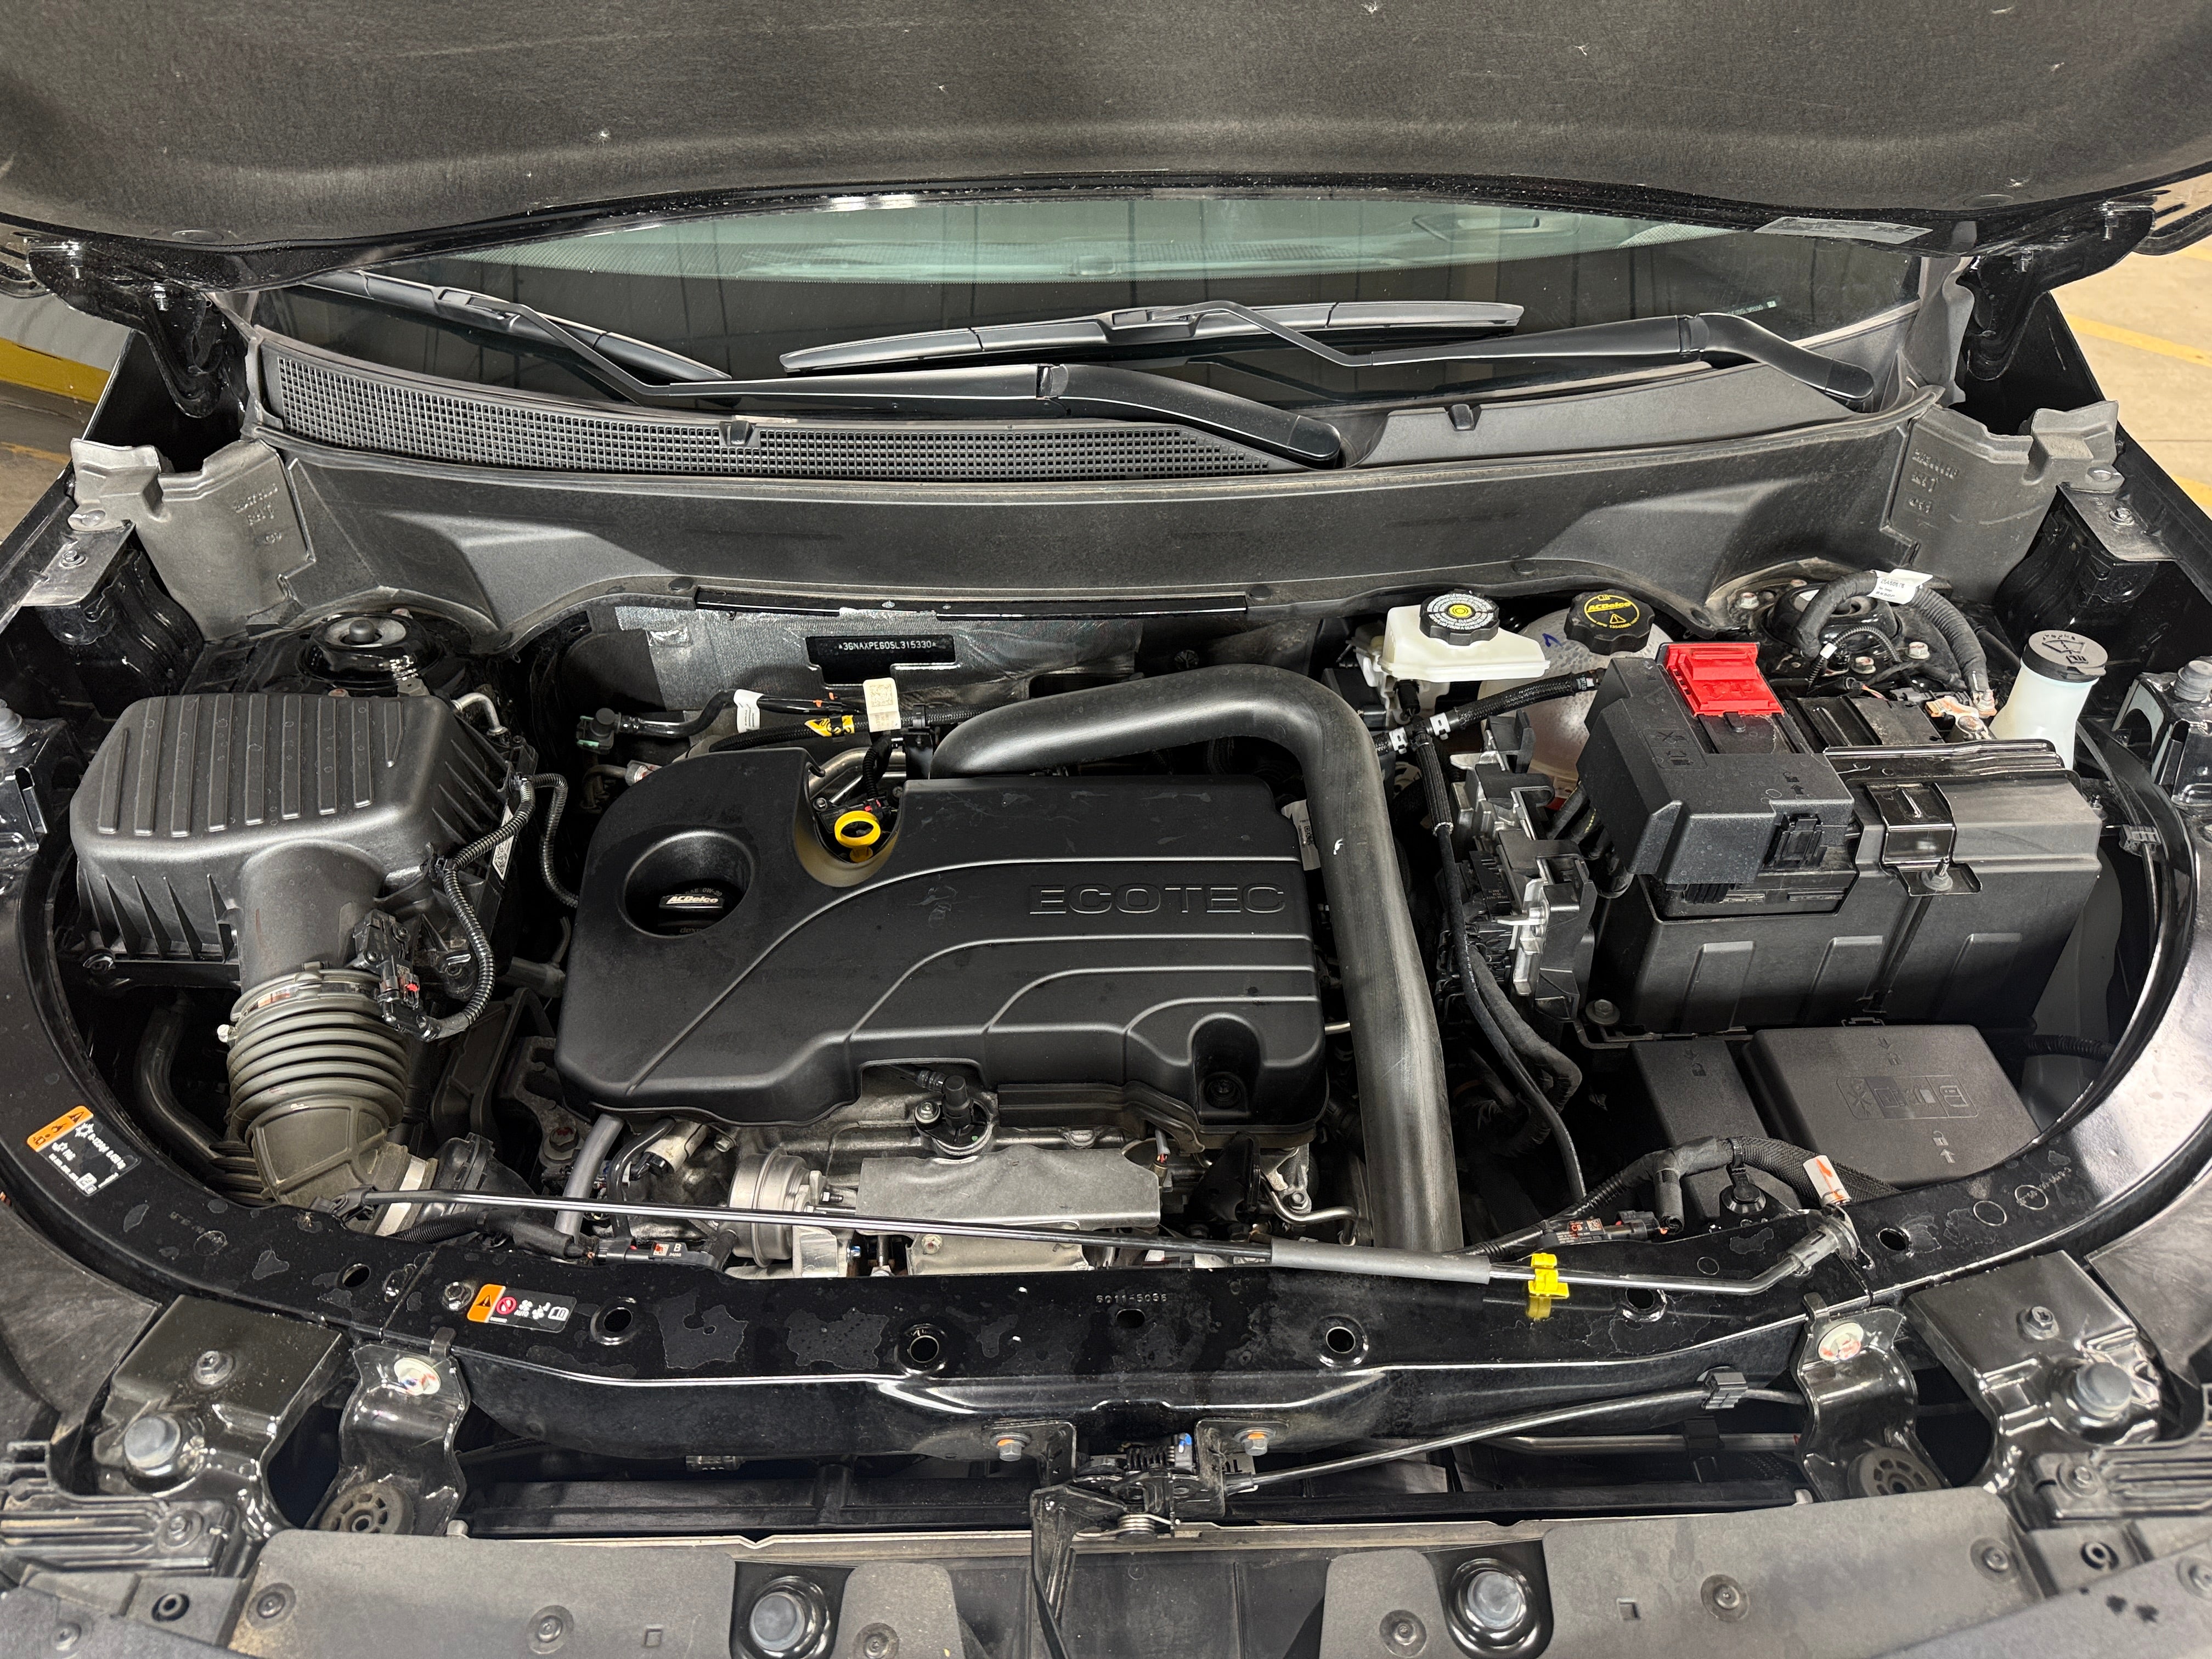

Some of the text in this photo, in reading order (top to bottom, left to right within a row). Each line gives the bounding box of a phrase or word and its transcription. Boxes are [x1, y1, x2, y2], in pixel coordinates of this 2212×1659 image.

[1587, 602, 1632, 613] ACDelco
[702, 888, 723, 897] 0W-20
[666, 895, 719, 905] ACDelco
[1030, 883, 1285, 915] ECOTEC
[674, 1243, 681, 1251] B
[514, 1309, 529, 1317] AUTO
